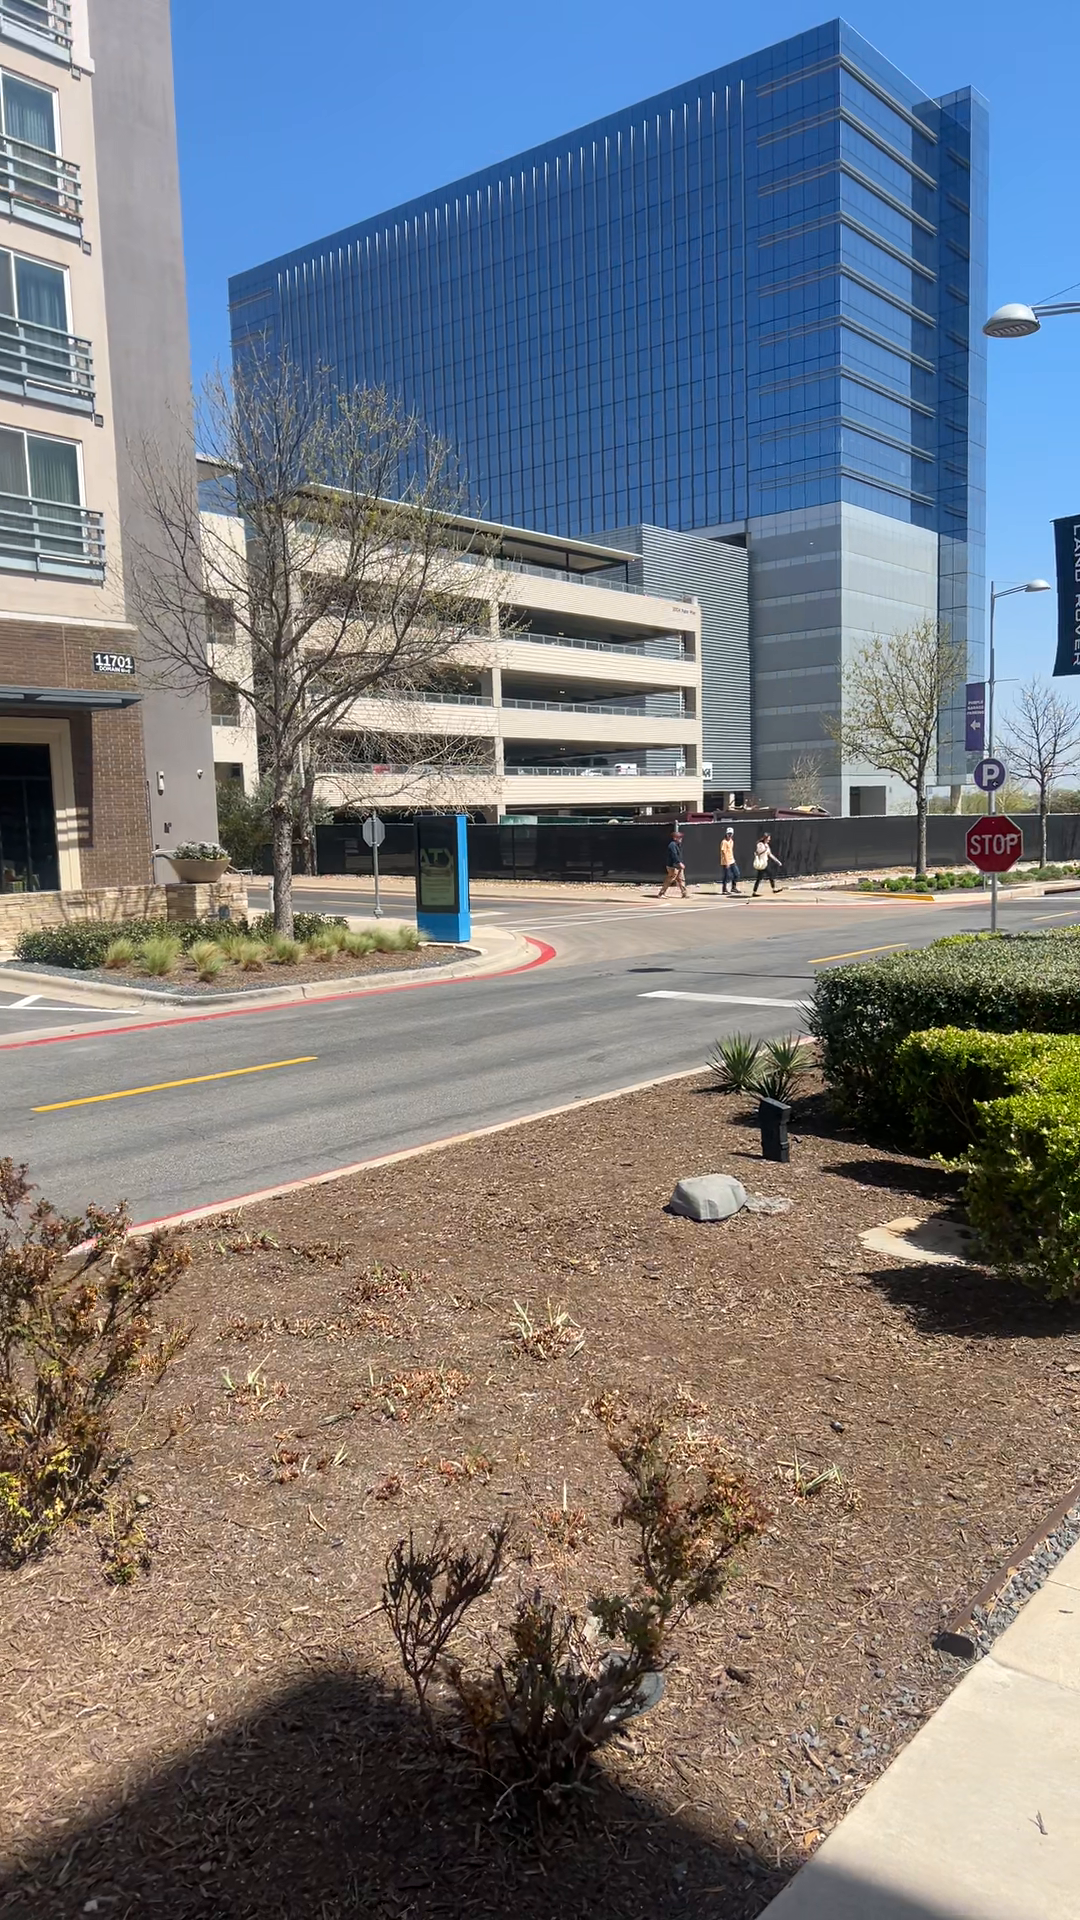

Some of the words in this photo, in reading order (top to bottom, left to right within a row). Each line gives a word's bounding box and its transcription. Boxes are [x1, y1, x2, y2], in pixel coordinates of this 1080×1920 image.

[95, 654, 133, 668] 11701
[982, 764, 1000, 786] P
[970, 834, 1019, 855] STOP
